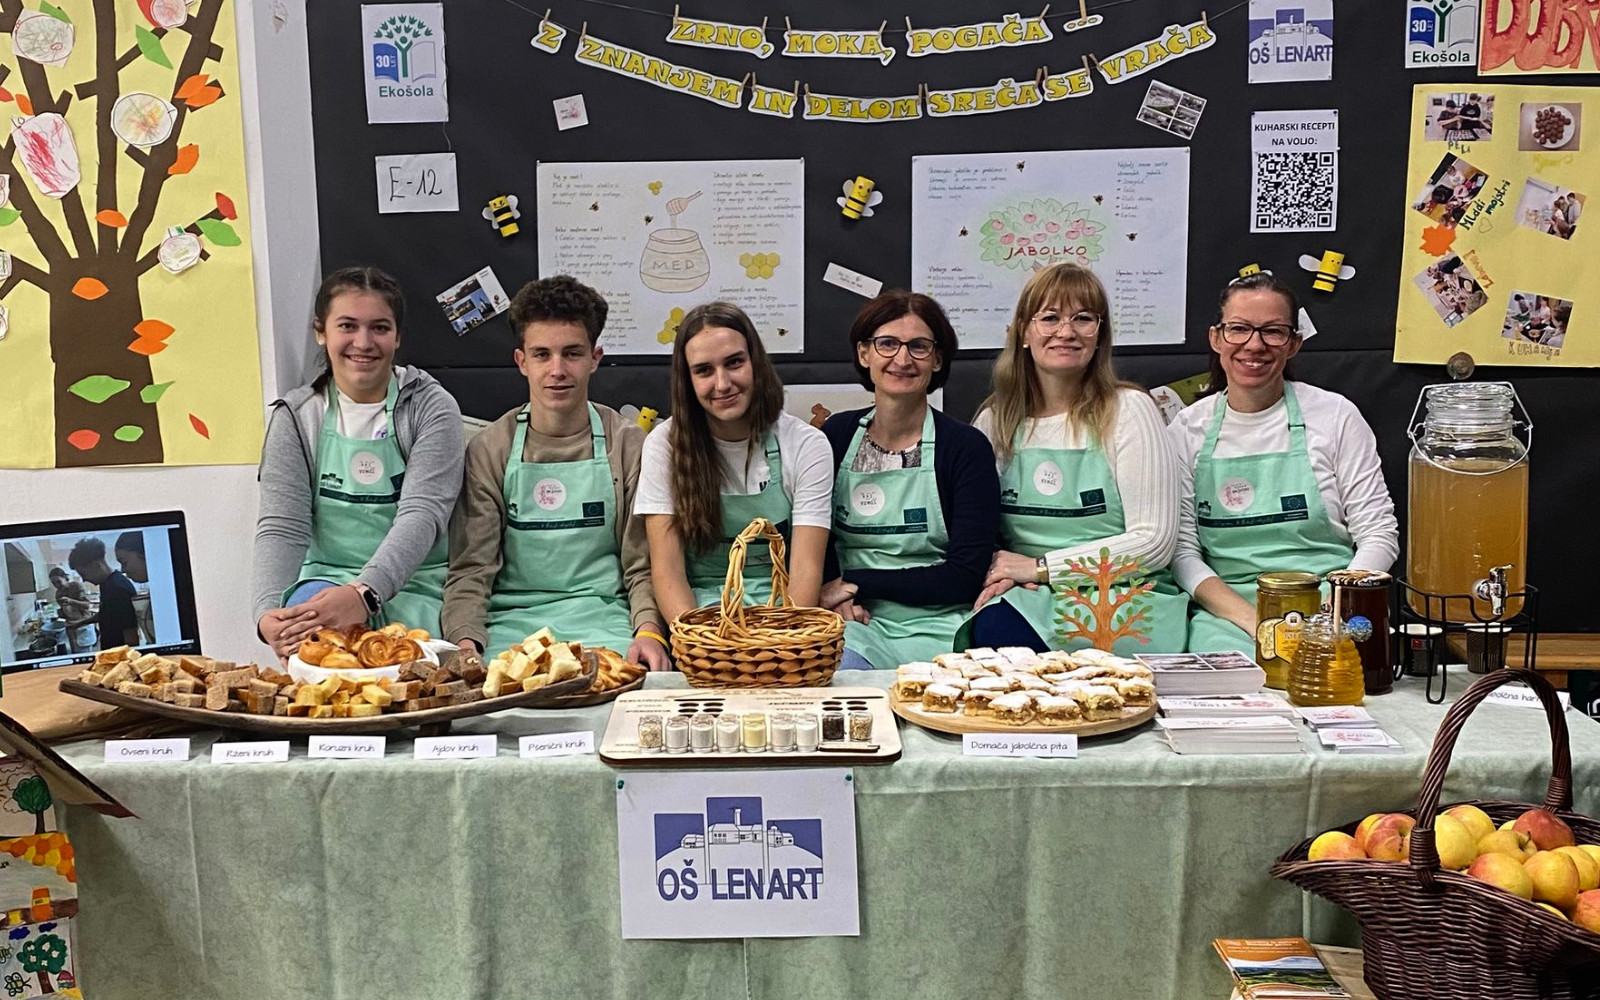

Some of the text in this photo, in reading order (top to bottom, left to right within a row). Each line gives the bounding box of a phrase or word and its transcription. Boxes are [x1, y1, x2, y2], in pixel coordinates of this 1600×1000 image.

[1412, 19, 1427, 33] 30
[671, 20, 771, 57] ZRNO,
[788, 33, 893, 61] MOKA,
[911, 15, 1049, 53] POGAČA
[1249, 42, 1333, 64] OŠ LENART
[1412, 50, 1470, 63] Ekošola
[376, 54, 390, 68] 30
[537, 24, 1214, 120] Z ZNANJEM IN DELOM SREČA SE VRAČA
[379, 85, 434, 97] Ekošola
[1254, 122, 1335, 132] KUHARSKI RECEPTI
[1271, 137, 1317, 146] NA VOLJO:
[389, 167, 442, 202] E-12
[1003, 245, 1087, 260] JABOLKO
[653, 259, 695, 271] MED
[152, 746, 173, 756] kruh
[432, 744, 455, 756] Ajdov
[971, 741, 1068, 753] Domača jabolčna pita
[658, 859, 823, 901] OŠ LENART
